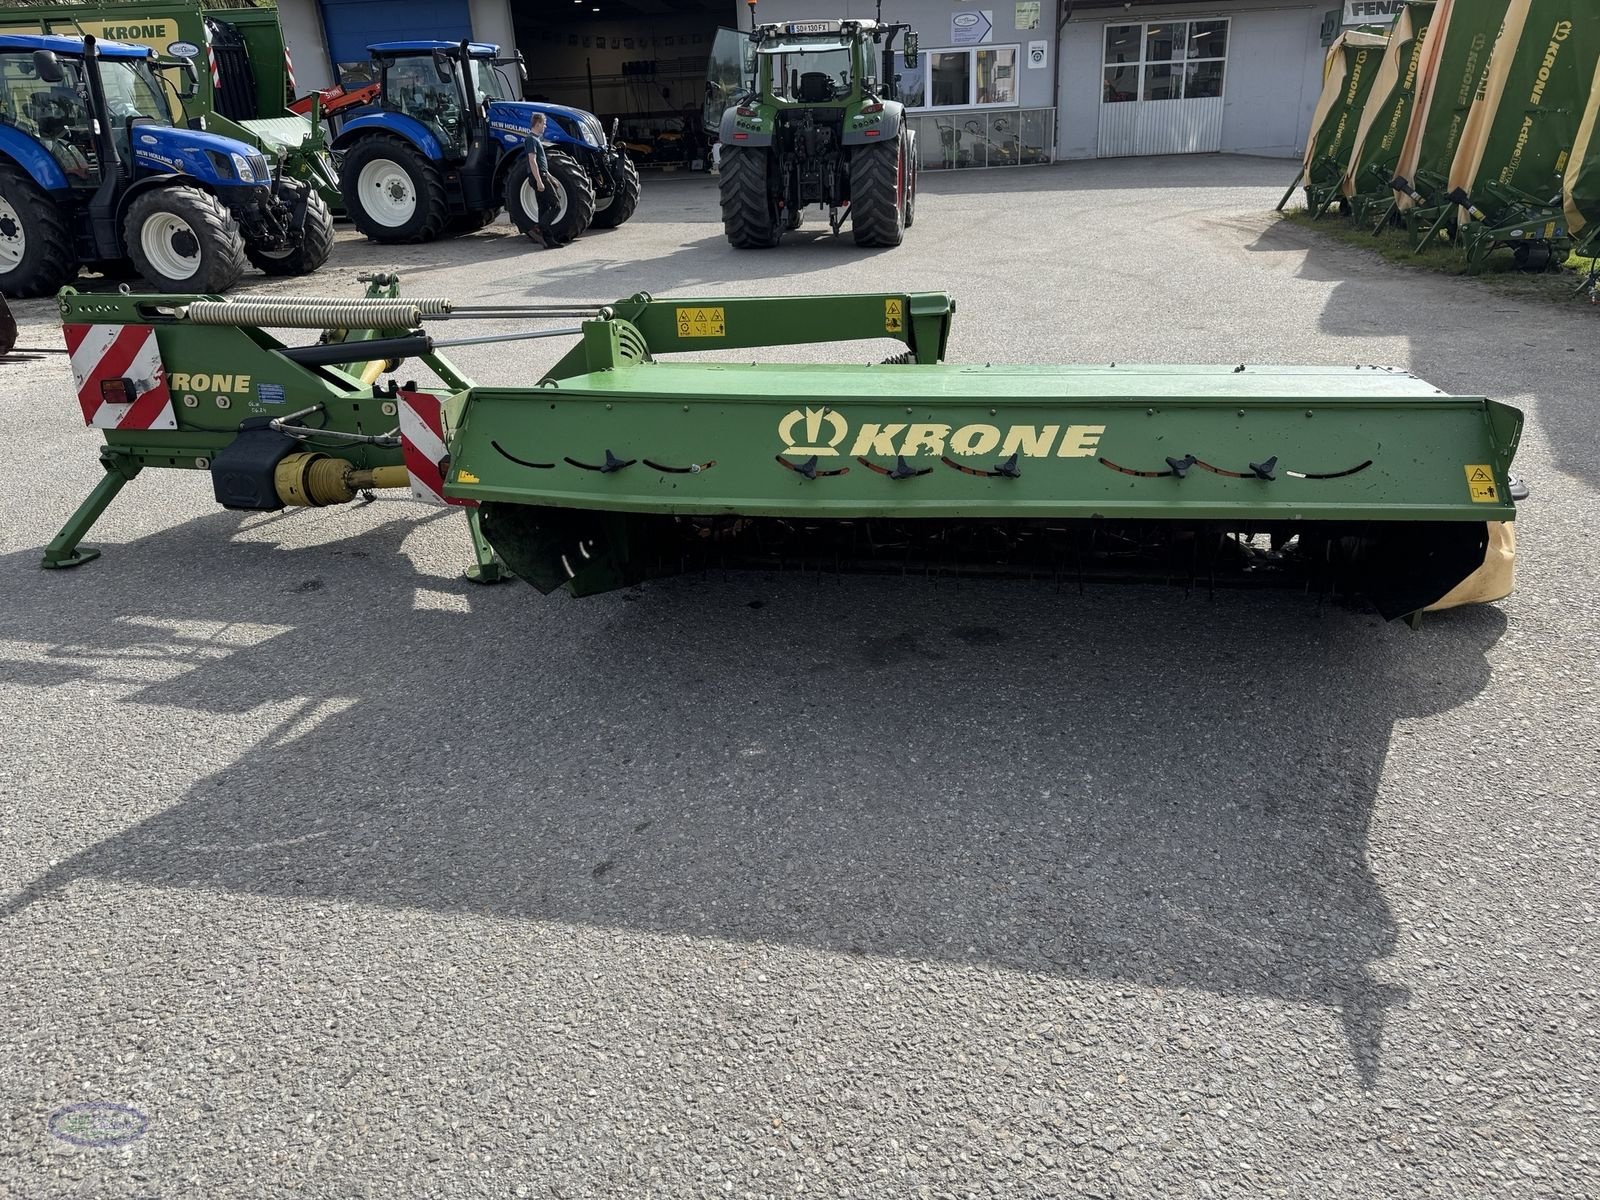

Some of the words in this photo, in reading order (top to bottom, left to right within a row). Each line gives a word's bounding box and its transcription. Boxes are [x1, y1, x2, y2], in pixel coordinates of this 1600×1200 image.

[1351, 1, 1404, 16] FEND
[103, 25, 166, 39] KRONE
[1403, 40, 1423, 90] KRONE
[1458, 50, 1479, 105] KRONE
[1530, 40, 1560, 105] KRONE
[1346, 64, 1362, 105] KRONE
[491, 121, 504, 129] NEW
[504, 123, 531, 134] HOLLAND
[167, 373, 251, 393] RONE
[850, 423, 1106, 458] KRONE
